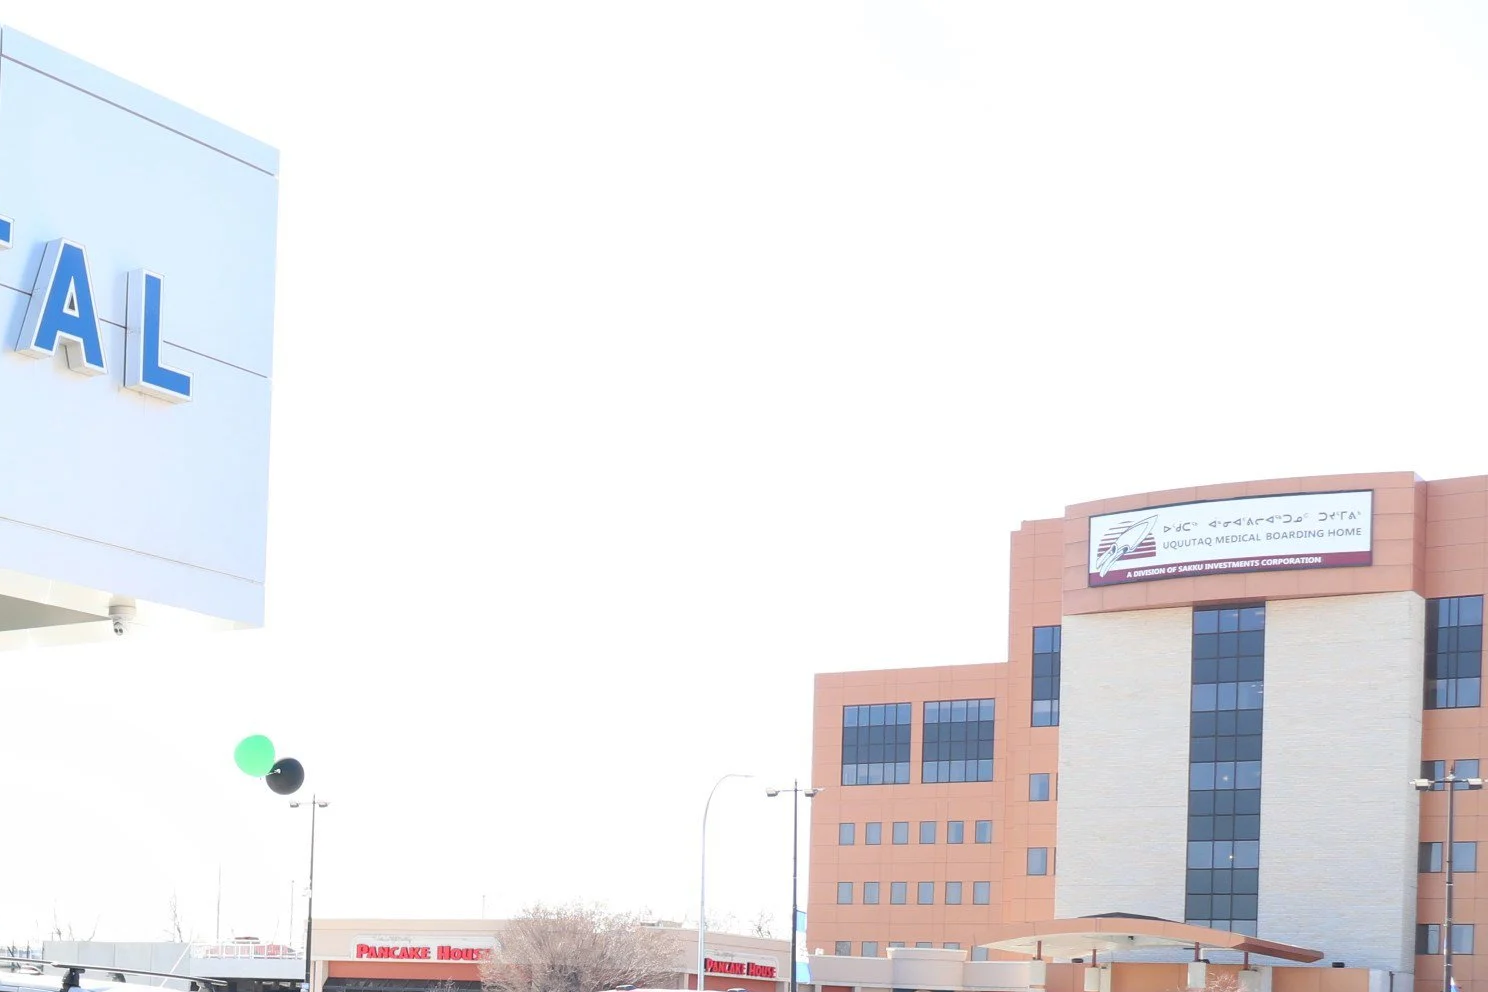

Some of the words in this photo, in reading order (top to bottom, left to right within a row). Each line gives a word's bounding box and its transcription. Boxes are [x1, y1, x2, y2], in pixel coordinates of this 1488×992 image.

[1163, 536, 1212, 550] UQUUTAQ
[1215, 533, 1261, 545] MEDICAL
[1266, 529, 1324, 541] BOARDING
[1328, 527, 1362, 537] HOME
[1126, 570, 1133, 578] A
[1134, 567, 1165, 578] DIVISION
[1167, 565, 1177, 574] OF
[1178, 562, 1203, 573] SAKKU
[1205, 559, 1260, 571] INVESTMENTS
[1261, 556, 1322, 567] CORPORATION
[356, 943, 431, 960] PANCAKE
